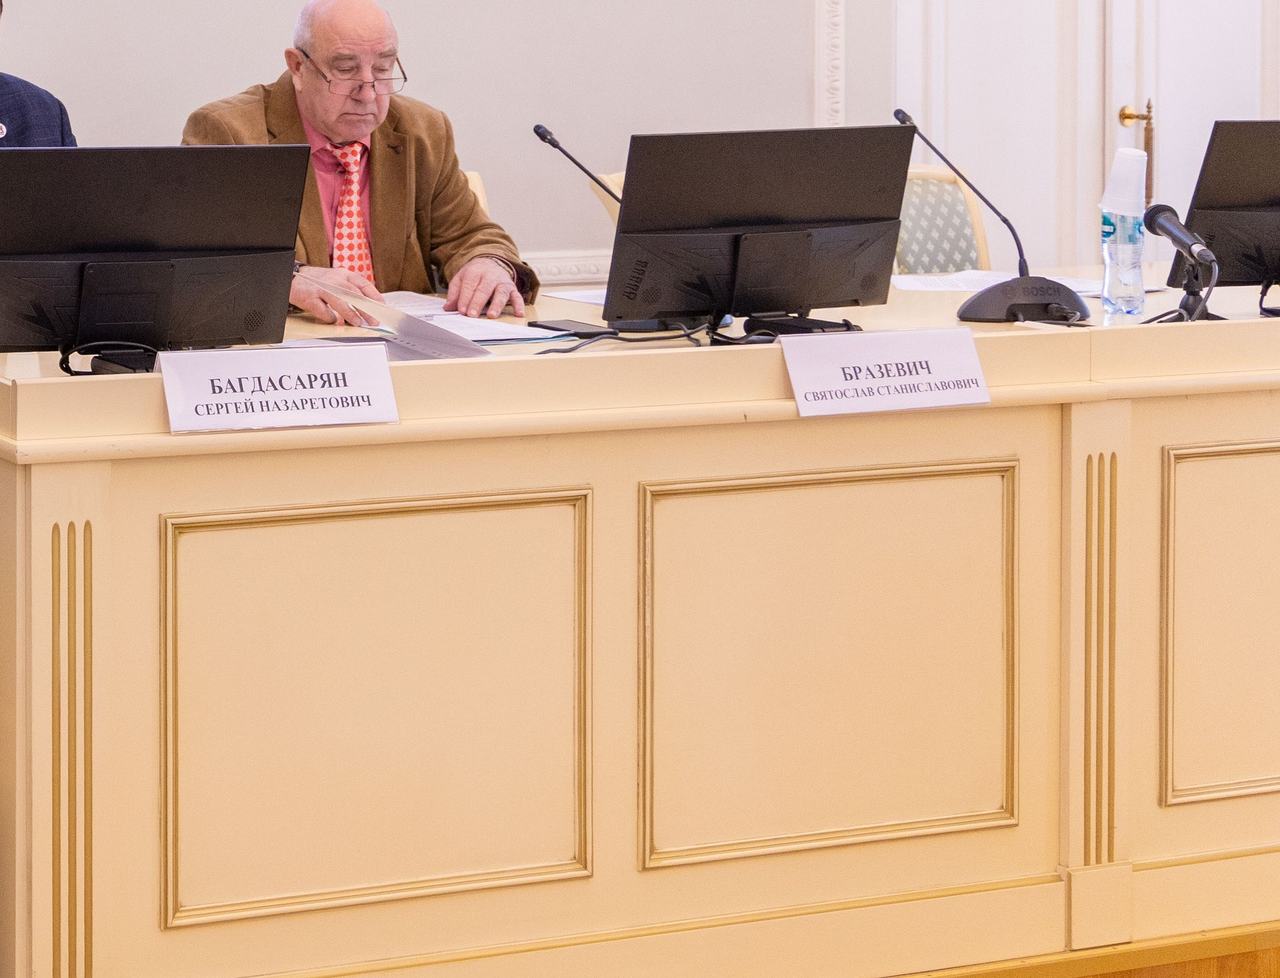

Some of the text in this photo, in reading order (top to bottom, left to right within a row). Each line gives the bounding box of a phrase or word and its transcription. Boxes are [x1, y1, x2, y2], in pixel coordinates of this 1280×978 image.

[840, 360, 933, 382] БРАЗЕВИЧ
[209, 372, 349, 395] БАГДАСАРЯН
[803, 378, 980, 402] СВЯТОСЛАВ СТАНИСЛАВОВИЧ
[194, 395, 372, 416] СЕРГЕЙ НАЗАРЕТОВИЧ
